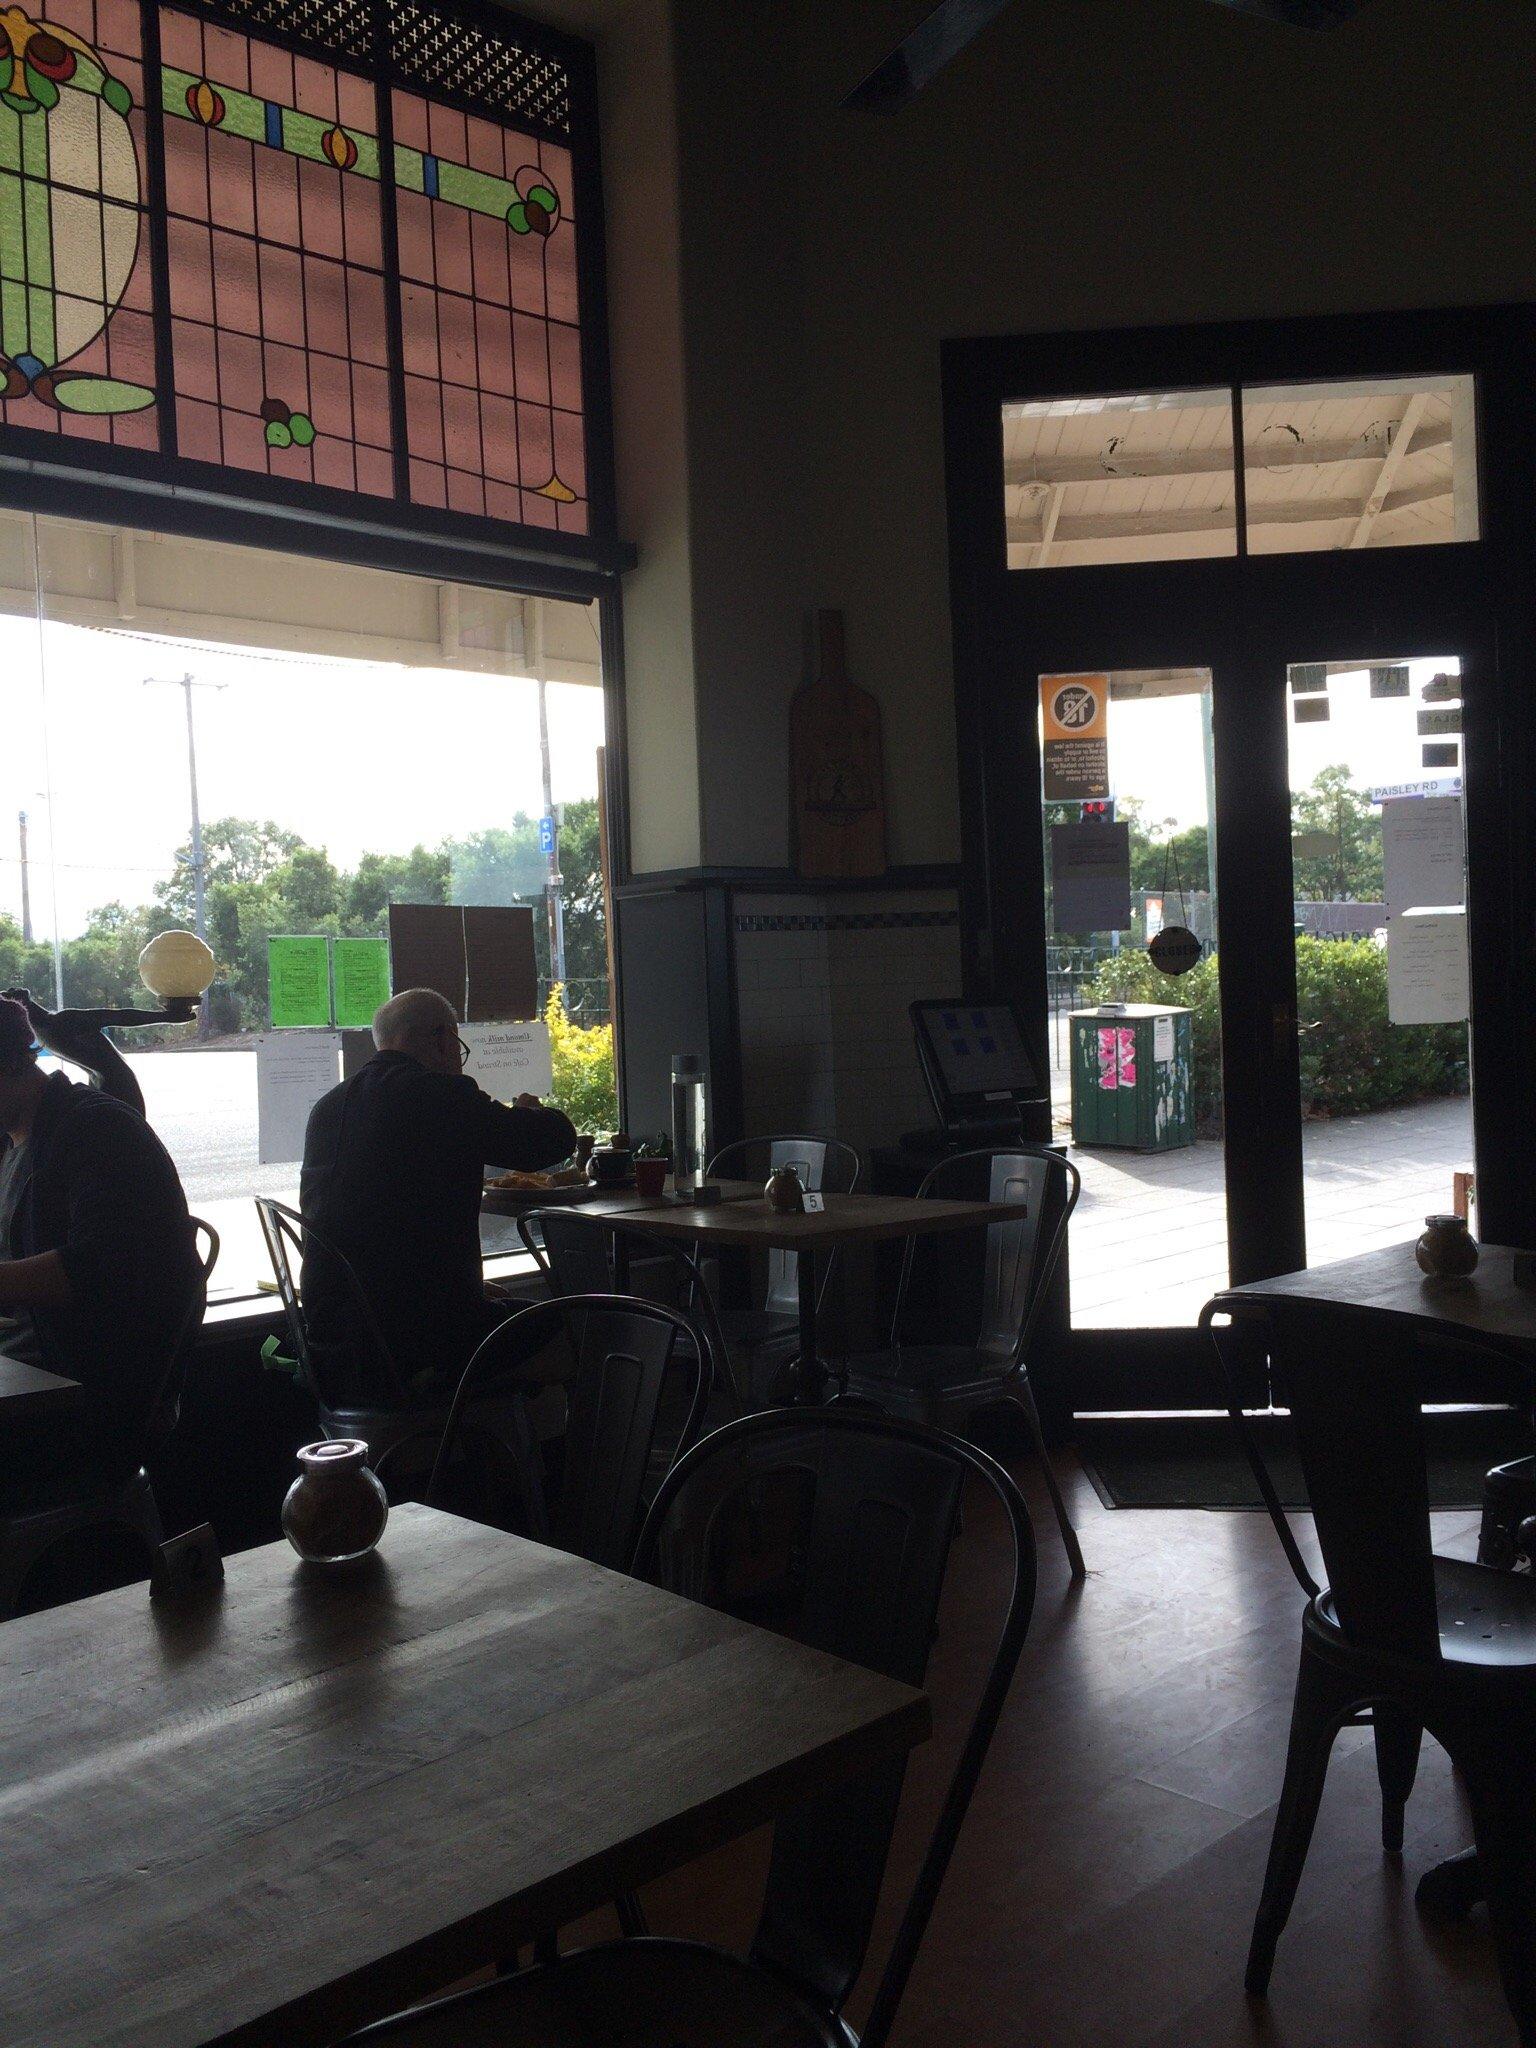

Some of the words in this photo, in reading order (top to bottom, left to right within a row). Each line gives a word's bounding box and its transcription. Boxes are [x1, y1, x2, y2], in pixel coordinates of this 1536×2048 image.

[1374, 783, 1420, 797] PAISLEY
[1422, 781, 1438, 791] RD
[542, 832, 551, 849] P
[809, 1194, 819, 1209] 5
